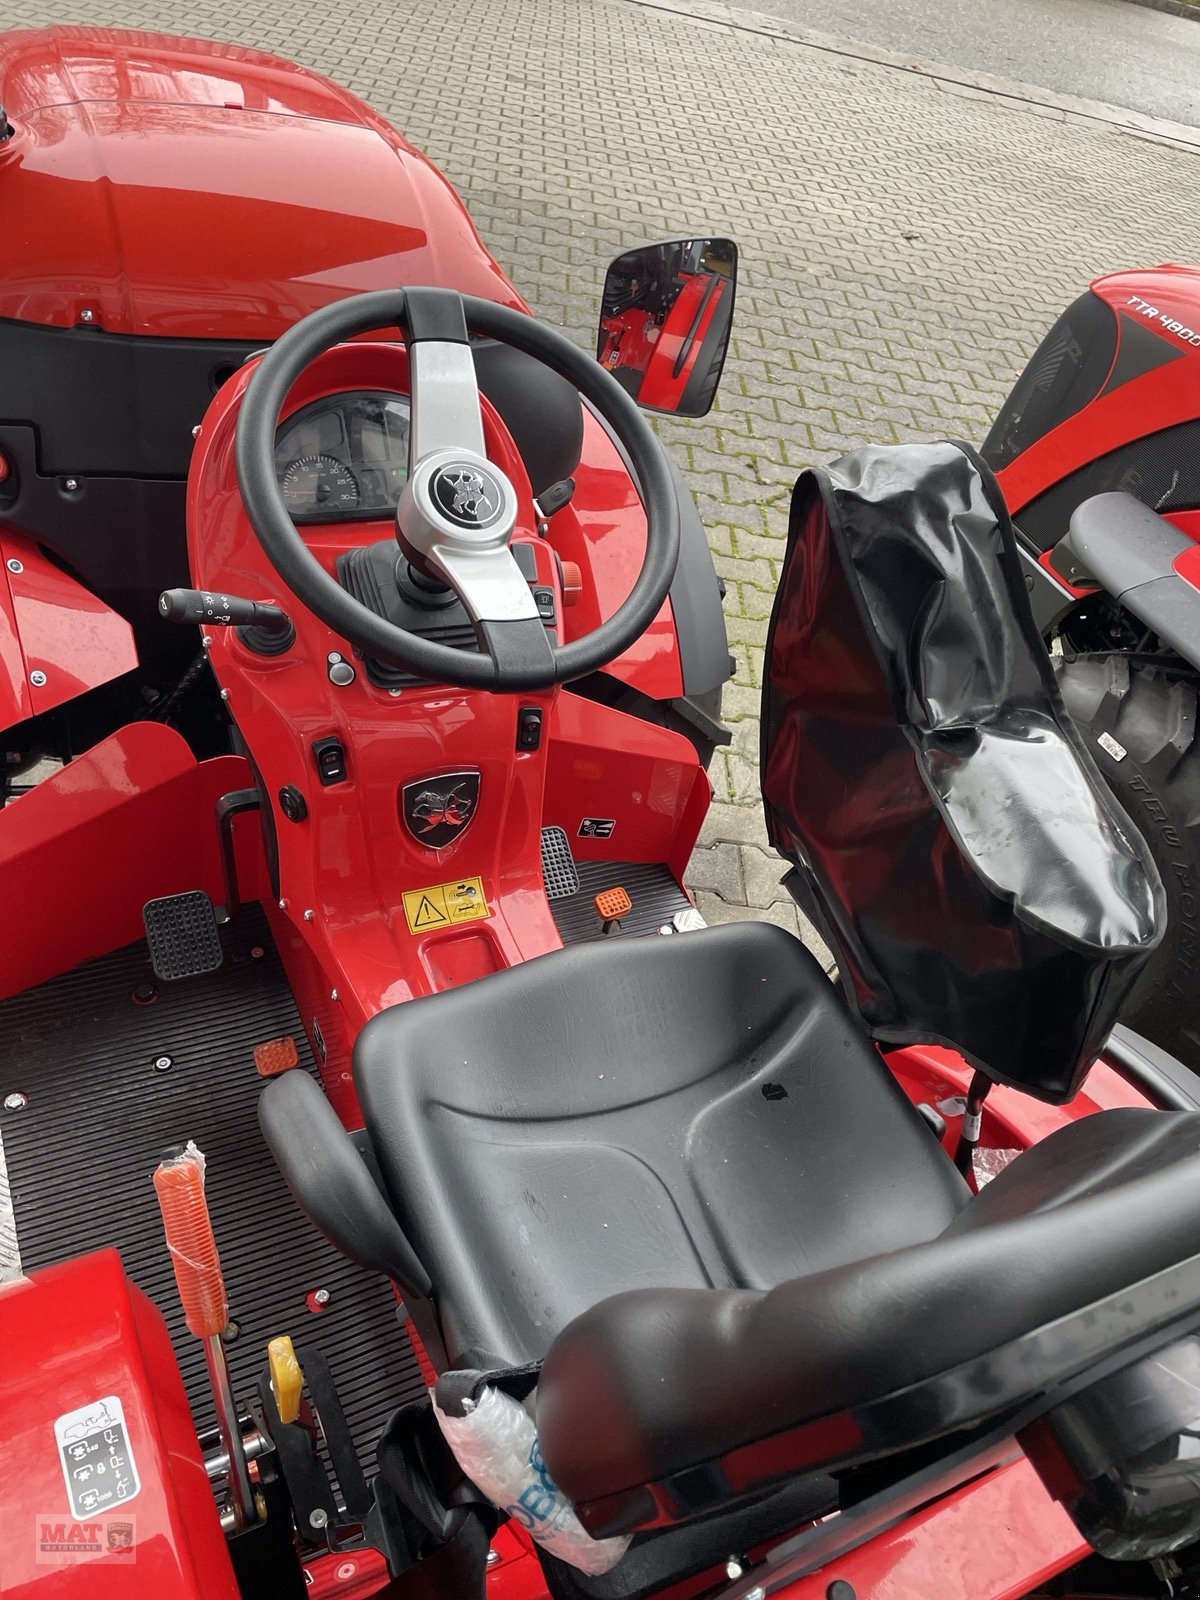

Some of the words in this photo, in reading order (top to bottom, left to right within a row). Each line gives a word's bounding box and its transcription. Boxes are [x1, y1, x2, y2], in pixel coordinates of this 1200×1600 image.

[1127, 295, 1159, 318] TTR
[1159, 314, 1200, 347] 4800
[1128, 774, 1183, 848] TRU
